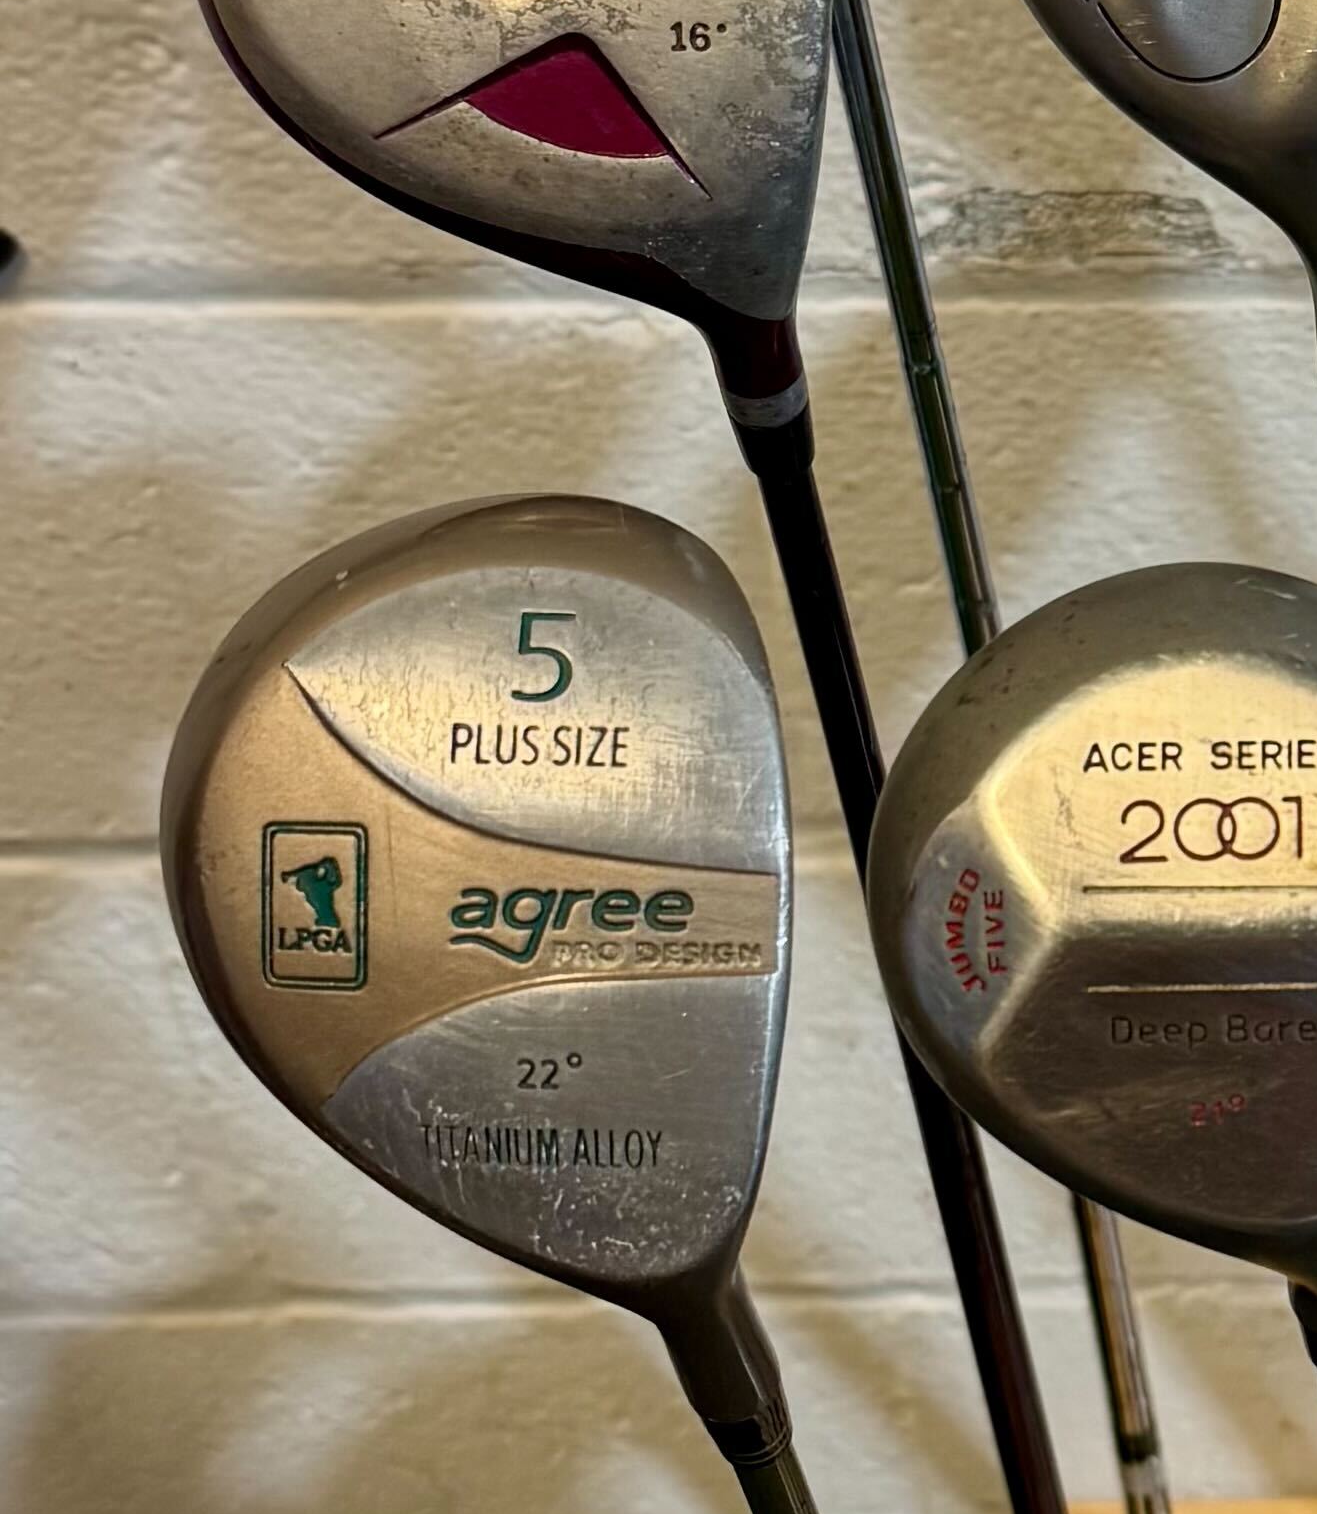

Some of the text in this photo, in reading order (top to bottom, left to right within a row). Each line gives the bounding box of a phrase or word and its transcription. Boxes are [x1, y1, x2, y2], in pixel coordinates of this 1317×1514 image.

[510, 611, 577, 703] 5
[449, 723, 630, 768] PLUS SIZE
[1083, 742, 1184, 773] ACER
[1119, 795, 1304, 864] 2001
[277, 926, 352, 954] LPGA
[449, 886, 694, 965] agree
[945, 867, 987, 994] JUMBO
[985, 889, 1008, 974] FIVE
[552, 940, 762, 967] PRO DESIGN
[1110, 1016, 1207, 1049] Deep
[517, 1052, 584, 1090] 22°
[417, 1125, 662, 1168] TITANIUM ALLOY
